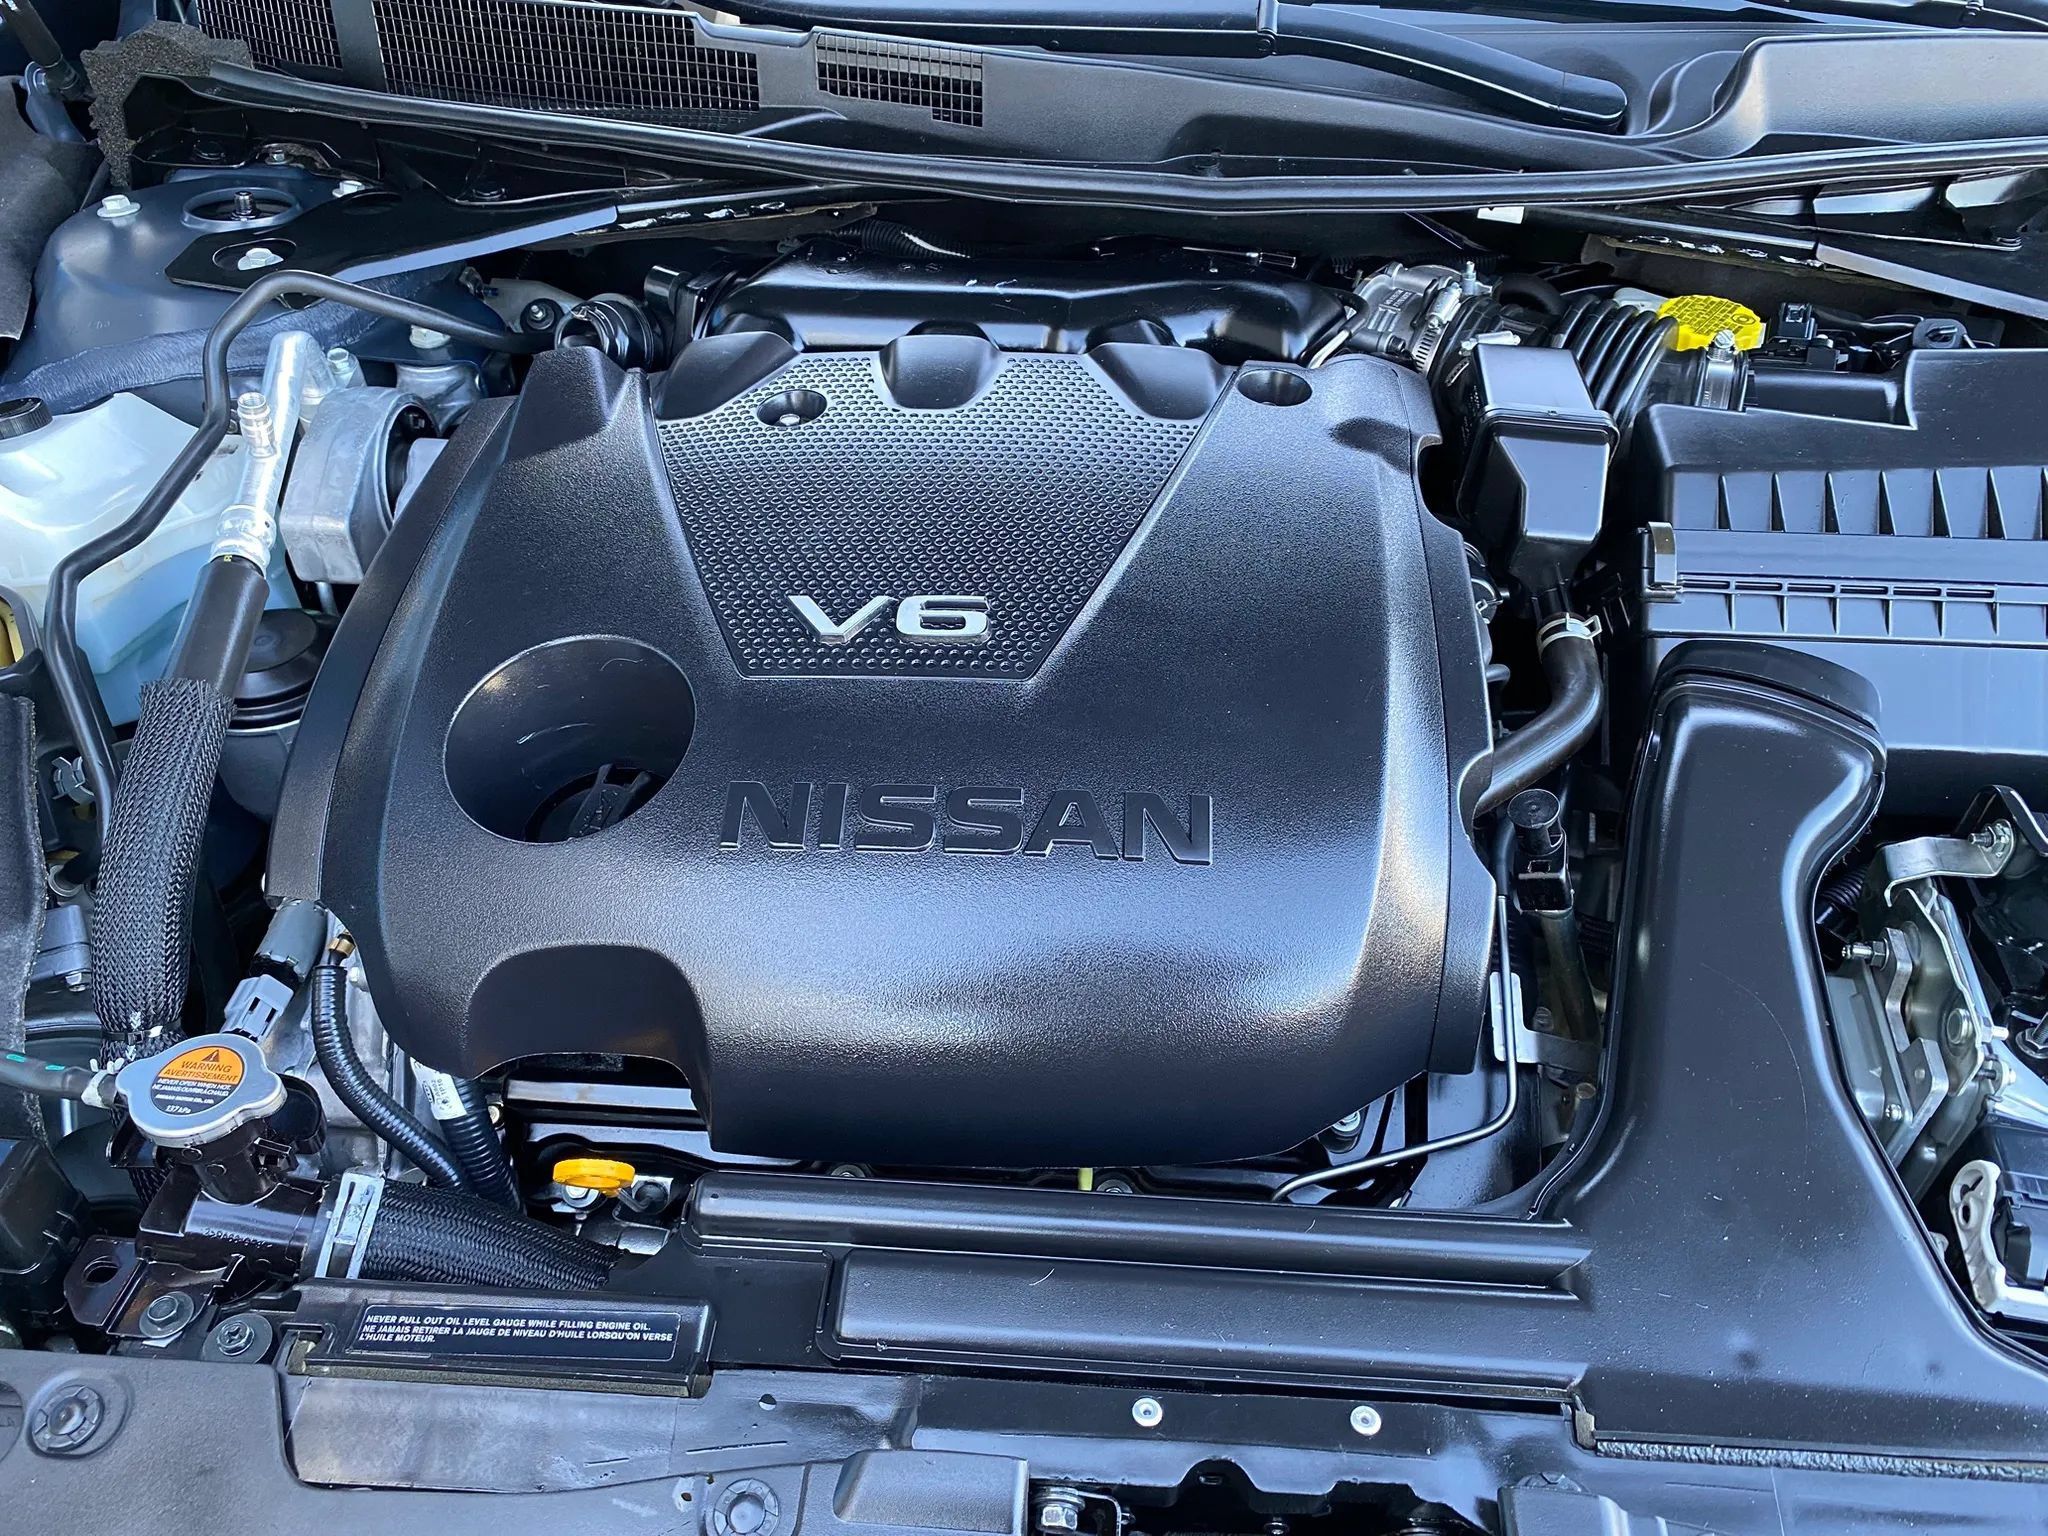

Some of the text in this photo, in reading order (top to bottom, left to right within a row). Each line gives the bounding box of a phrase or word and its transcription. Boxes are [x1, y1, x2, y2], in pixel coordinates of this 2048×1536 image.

[787, 595, 992, 645] V6
[719, 780, 1214, 866] NISSAN
[182, 1061, 232, 1072] WARNING
[164, 1069, 239, 1082] AVERTISSEMENT
[366, 1315, 651, 1331] NEVER PULL OUT OIL LEVEL GAUGE WHILE FILLING ENGINE OIL.
[358, 1333, 436, 1342] L'HUILE MOTEUR.
[362, 1325, 375, 1333] NE
[377, 1326, 411, 1334] JAMAIS
[412, 1326, 450, 1335] RETIRER
[451, 1327, 464, 1335] LA
[465, 1328, 496, 1336] JAUGE
[512, 1329, 546, 1338] NIVEAU
[549, 1330, 584, 1339] D'HUILE
[586, 1331, 641, 1340] LORSQU'ON
[642, 1333, 674, 1341] VERSE
